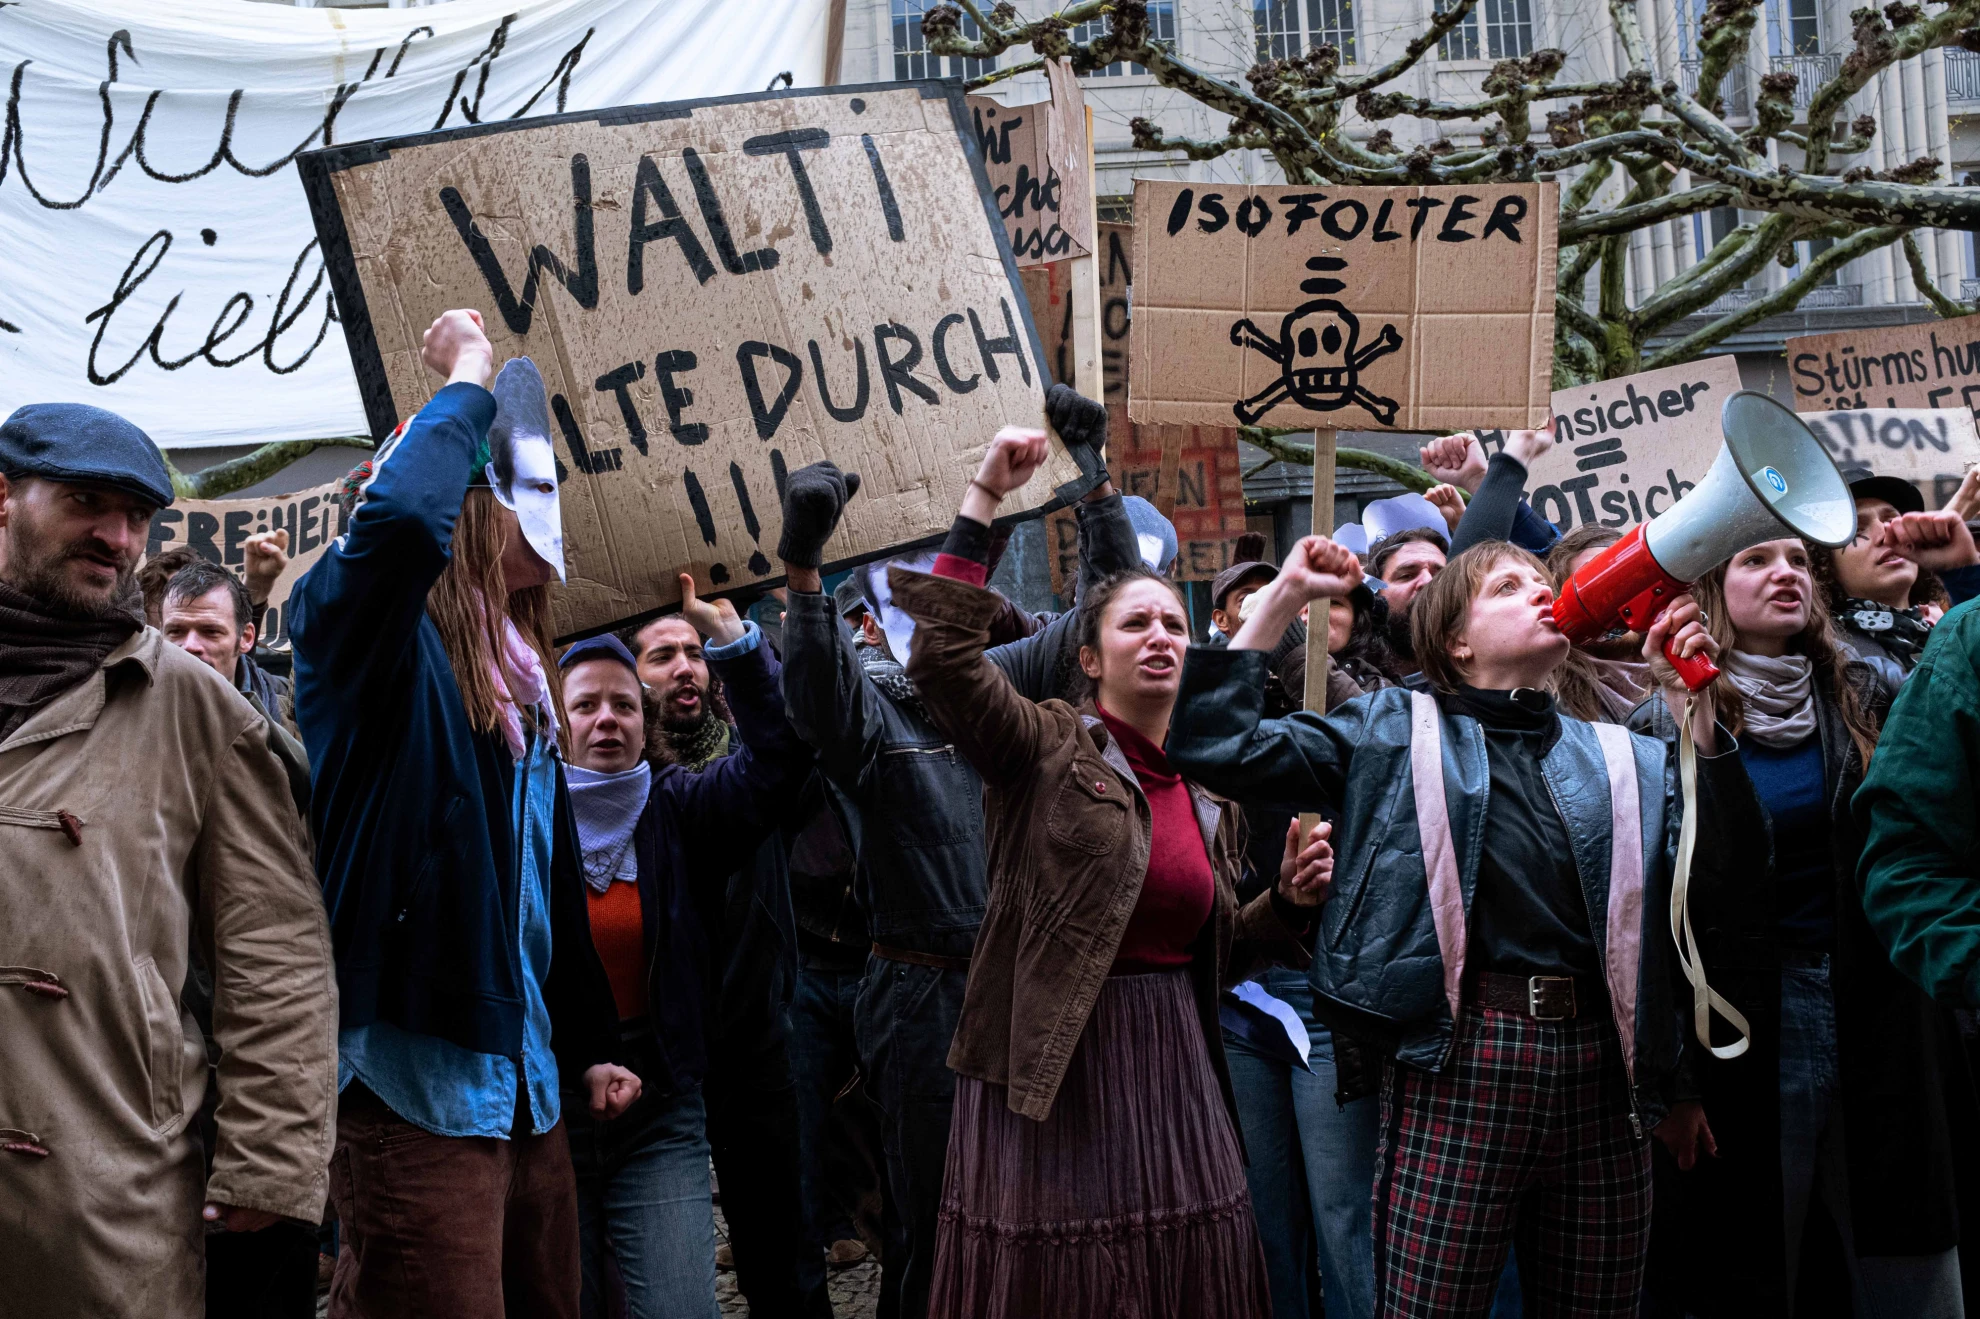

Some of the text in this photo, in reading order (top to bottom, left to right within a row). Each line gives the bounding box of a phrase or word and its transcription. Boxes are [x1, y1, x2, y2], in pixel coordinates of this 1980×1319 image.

[1167, 188, 1528, 244] ISOFOLTER
[553, 350, 709, 485] LTE
[736, 297, 1031, 441] DURCH
[1793, 346, 1928, 396] Stürms
[1521, 468, 1708, 533] OTsich
